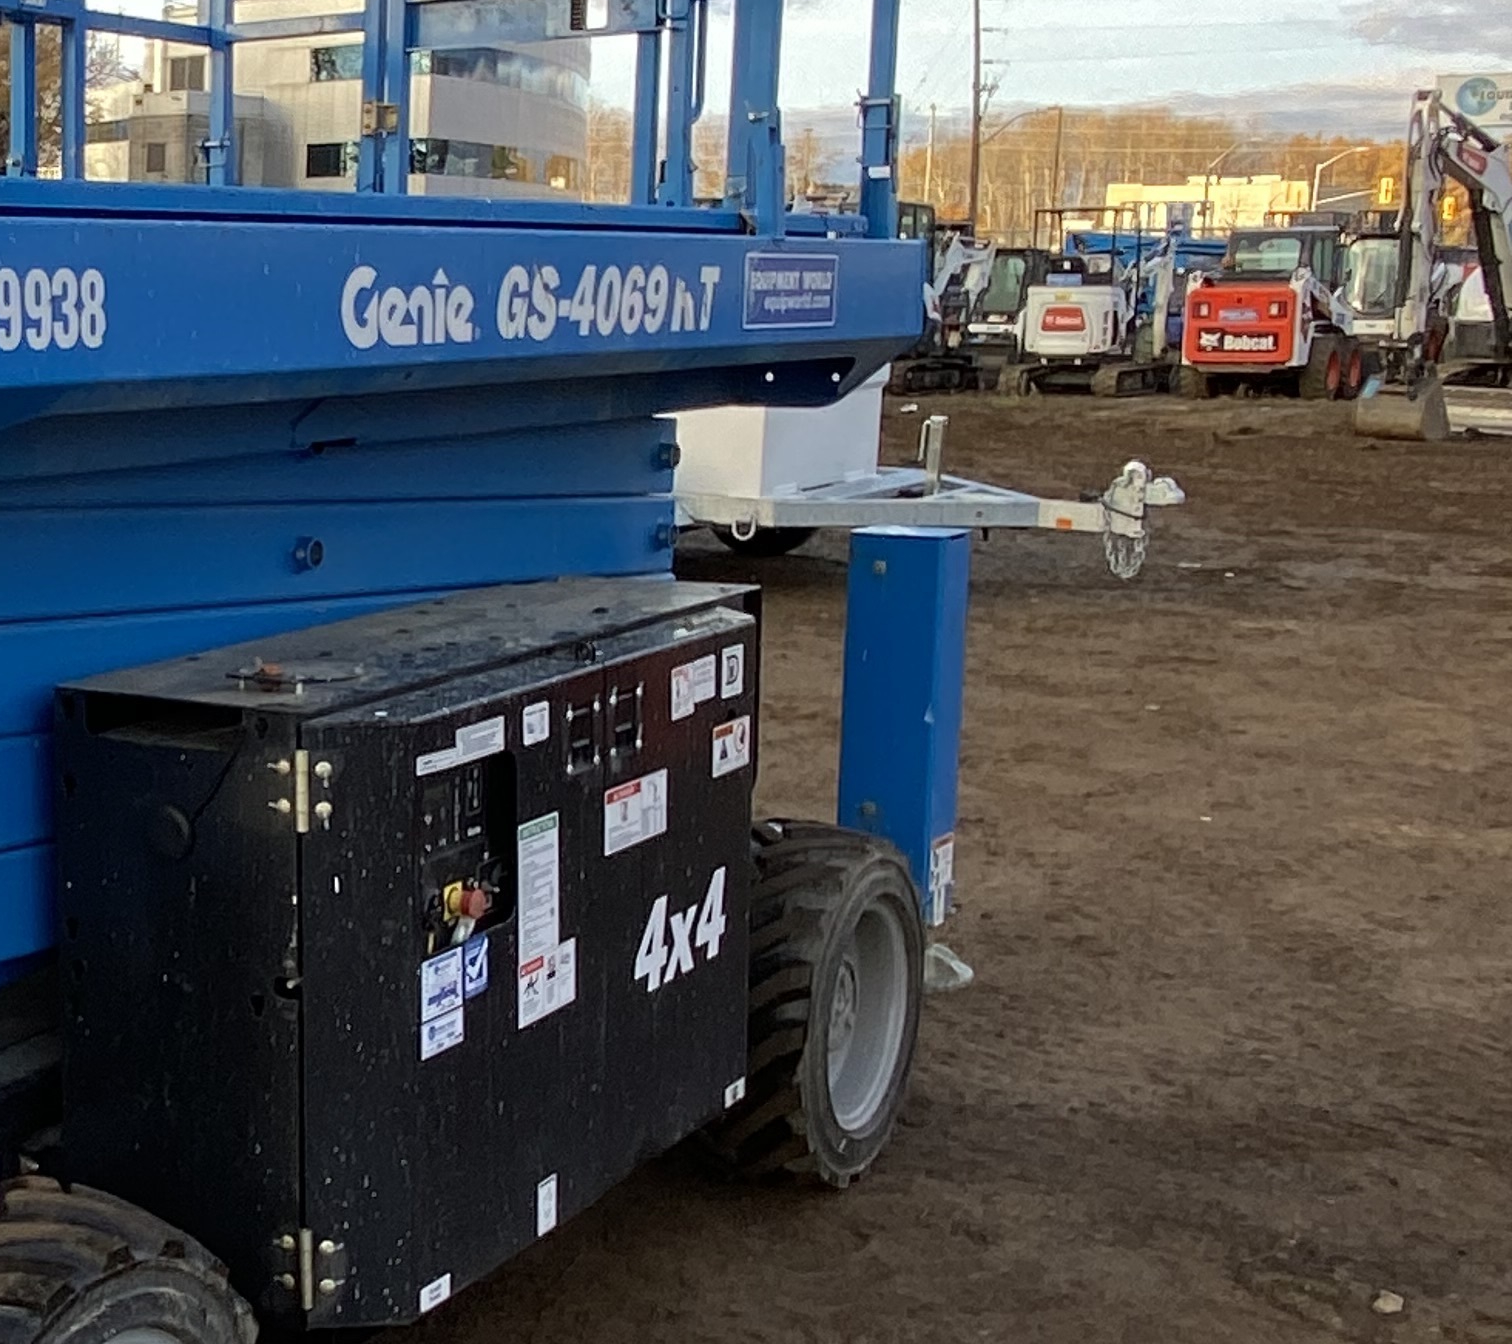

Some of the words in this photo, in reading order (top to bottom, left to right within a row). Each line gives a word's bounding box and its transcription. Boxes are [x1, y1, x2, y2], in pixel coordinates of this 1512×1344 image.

[341, 265, 480, 350] Genie
[497, 264, 668, 342] GS-4069
[634, 865, 727, 993] 4x4
